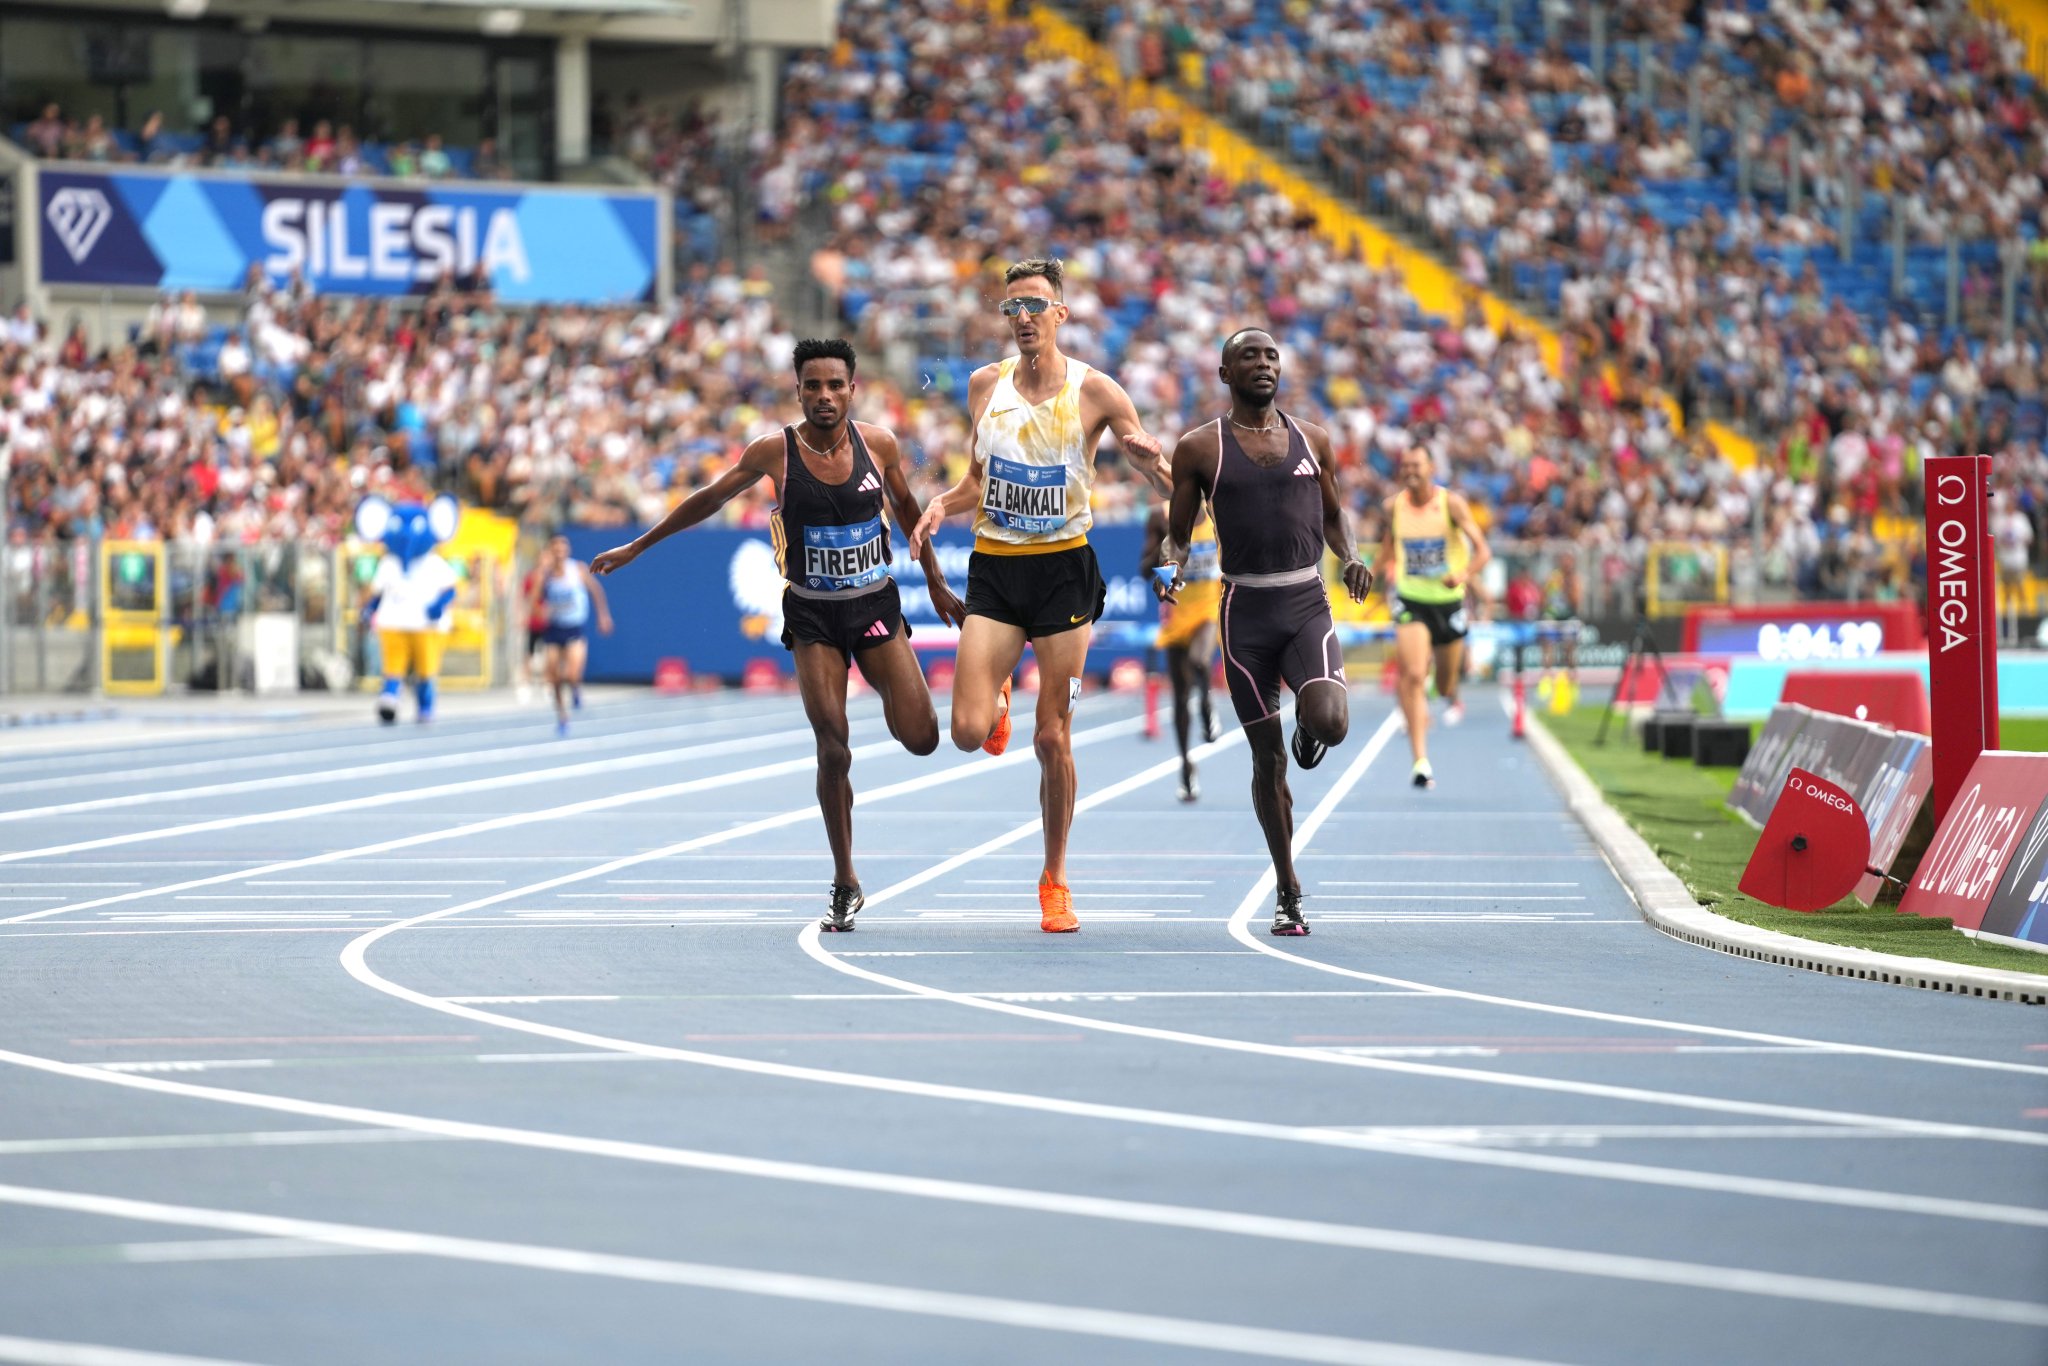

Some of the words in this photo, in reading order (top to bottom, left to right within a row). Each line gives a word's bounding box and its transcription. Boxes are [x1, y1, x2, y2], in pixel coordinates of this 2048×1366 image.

[262, 198, 531, 283] SILESIA
[985, 477, 1002, 509] EL
[1006, 482, 1064, 516] BAKKALI
[1008, 516, 1054, 531] SILESIA
[807, 536, 881, 576] FIREWU
[1938, 519, 1969, 653] OMEGA
[1806, 784, 1853, 815] OMEGA
[1937, 803, 2028, 901] OMEGA
